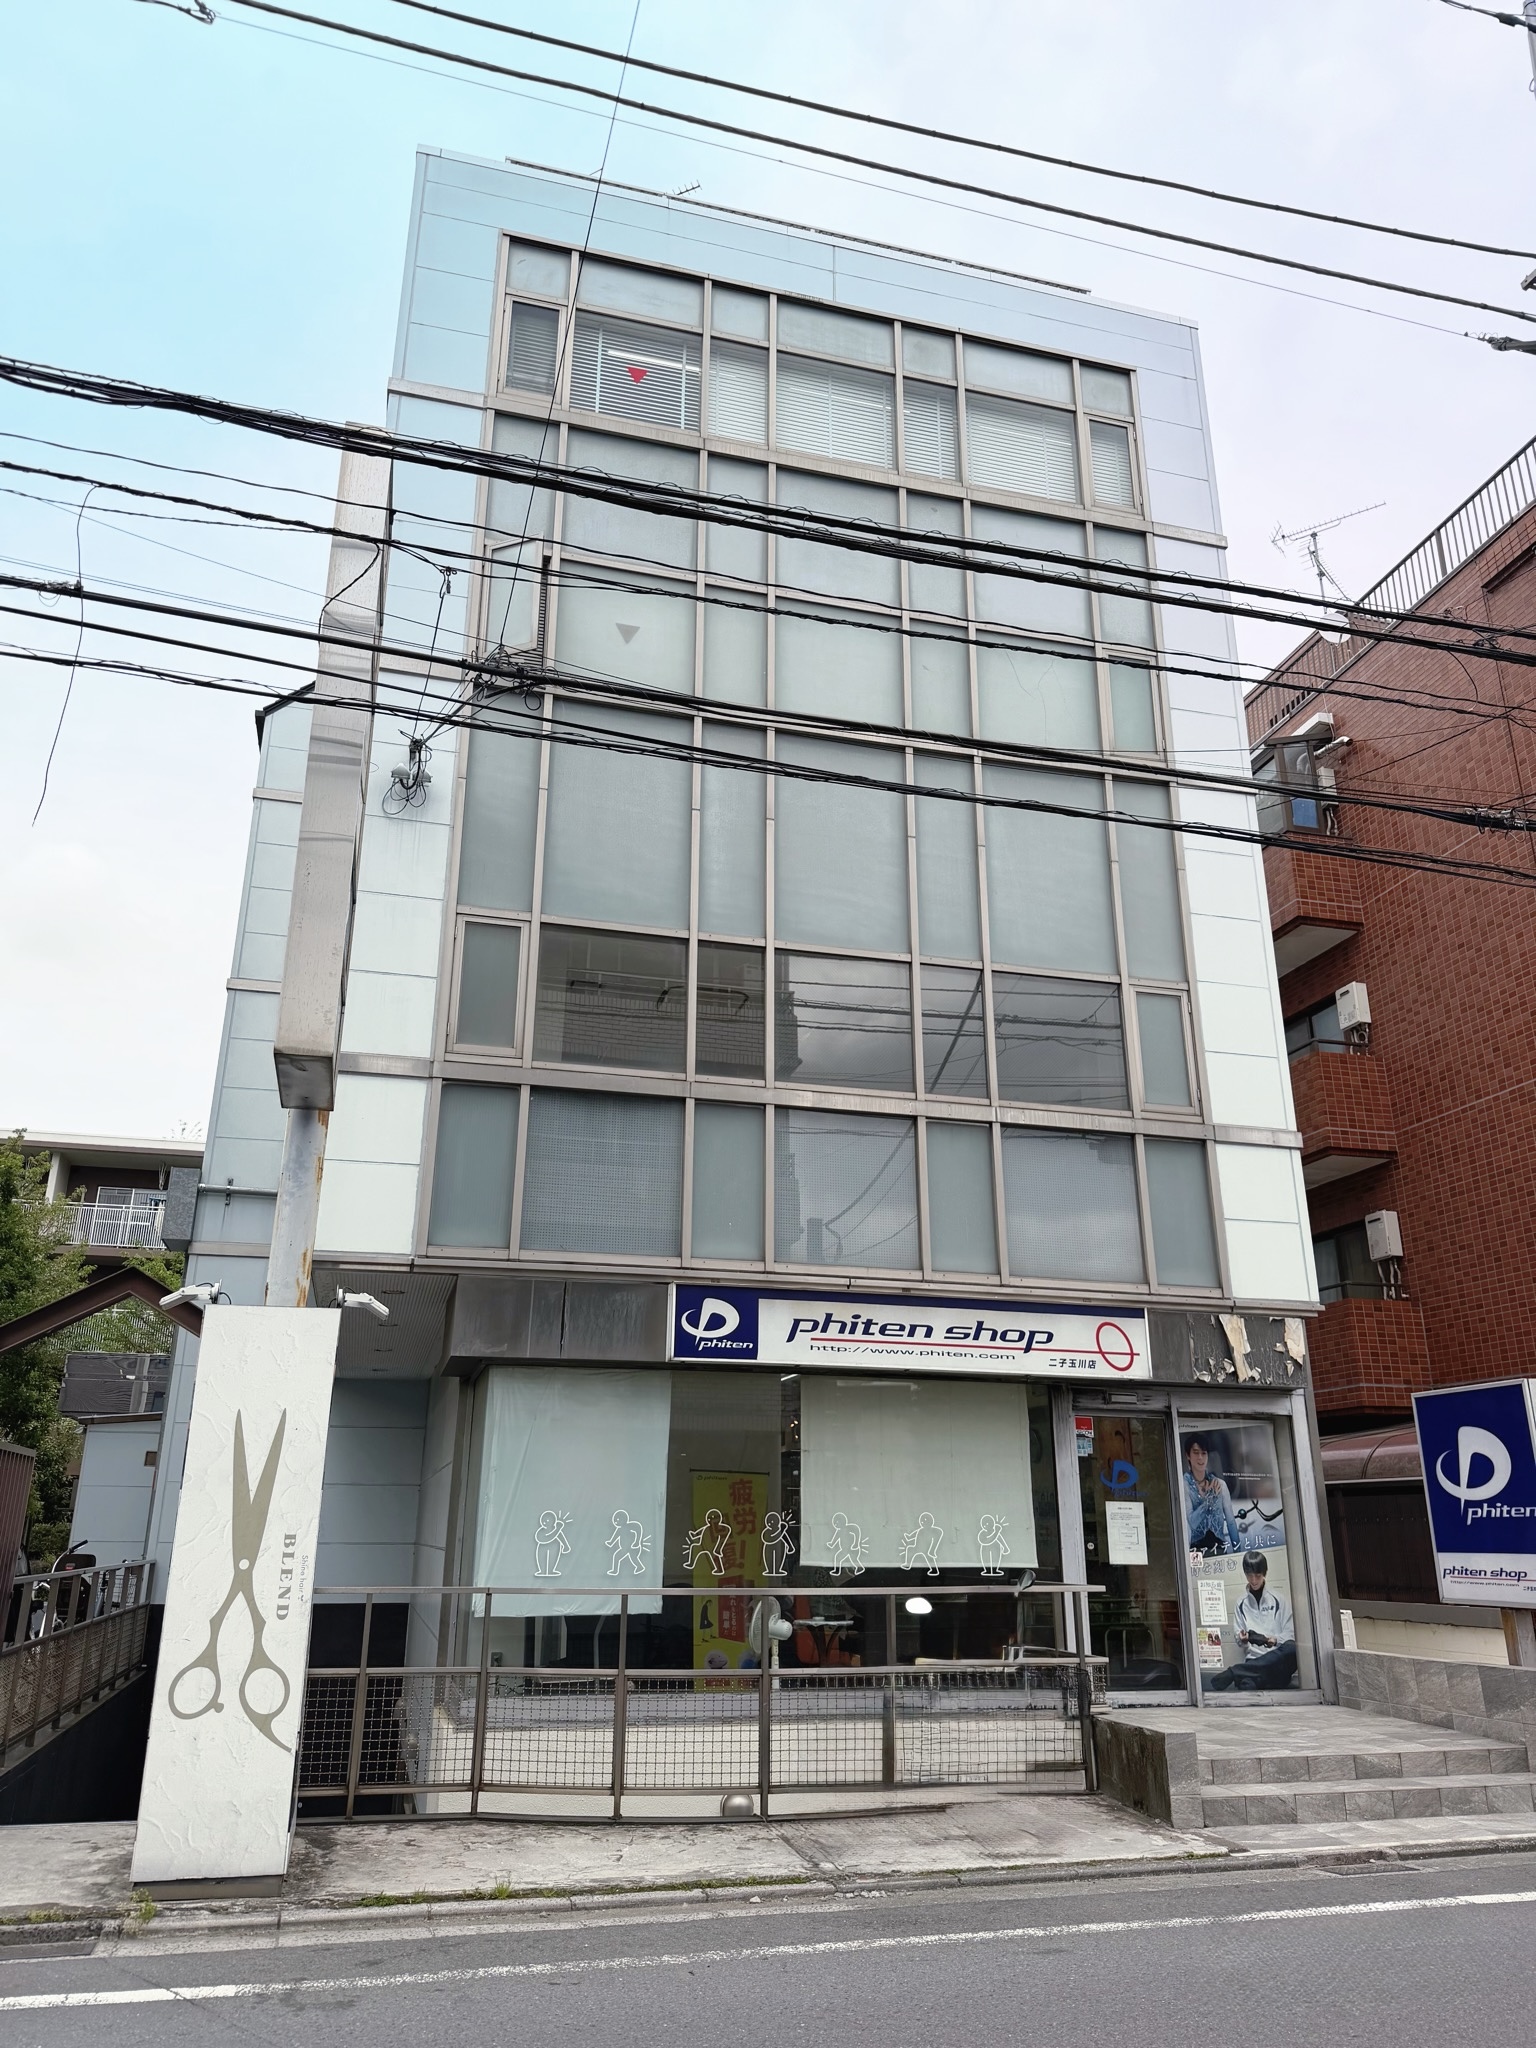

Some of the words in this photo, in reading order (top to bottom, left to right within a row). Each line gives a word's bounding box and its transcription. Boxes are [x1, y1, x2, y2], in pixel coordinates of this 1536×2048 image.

[785, 1312, 935, 1343] phiten
[943, 1320, 1055, 1353] shop
[698, 1339, 754, 1351] phiten
[810, 1344, 1016, 1361] http://www.phiten.com
[1048, 1358, 1097, 1370] 二子玉川店
[1466, 1502, 1536, 1526] phiten
[300, 1555, 309, 1576] Shine
[276, 1533, 297, 1621] BLEND
[1443, 1566, 1487, 1579] phiten
[1490, 1567, 1528, 1583] shop
[298, 1577, 307, 1594] hair
